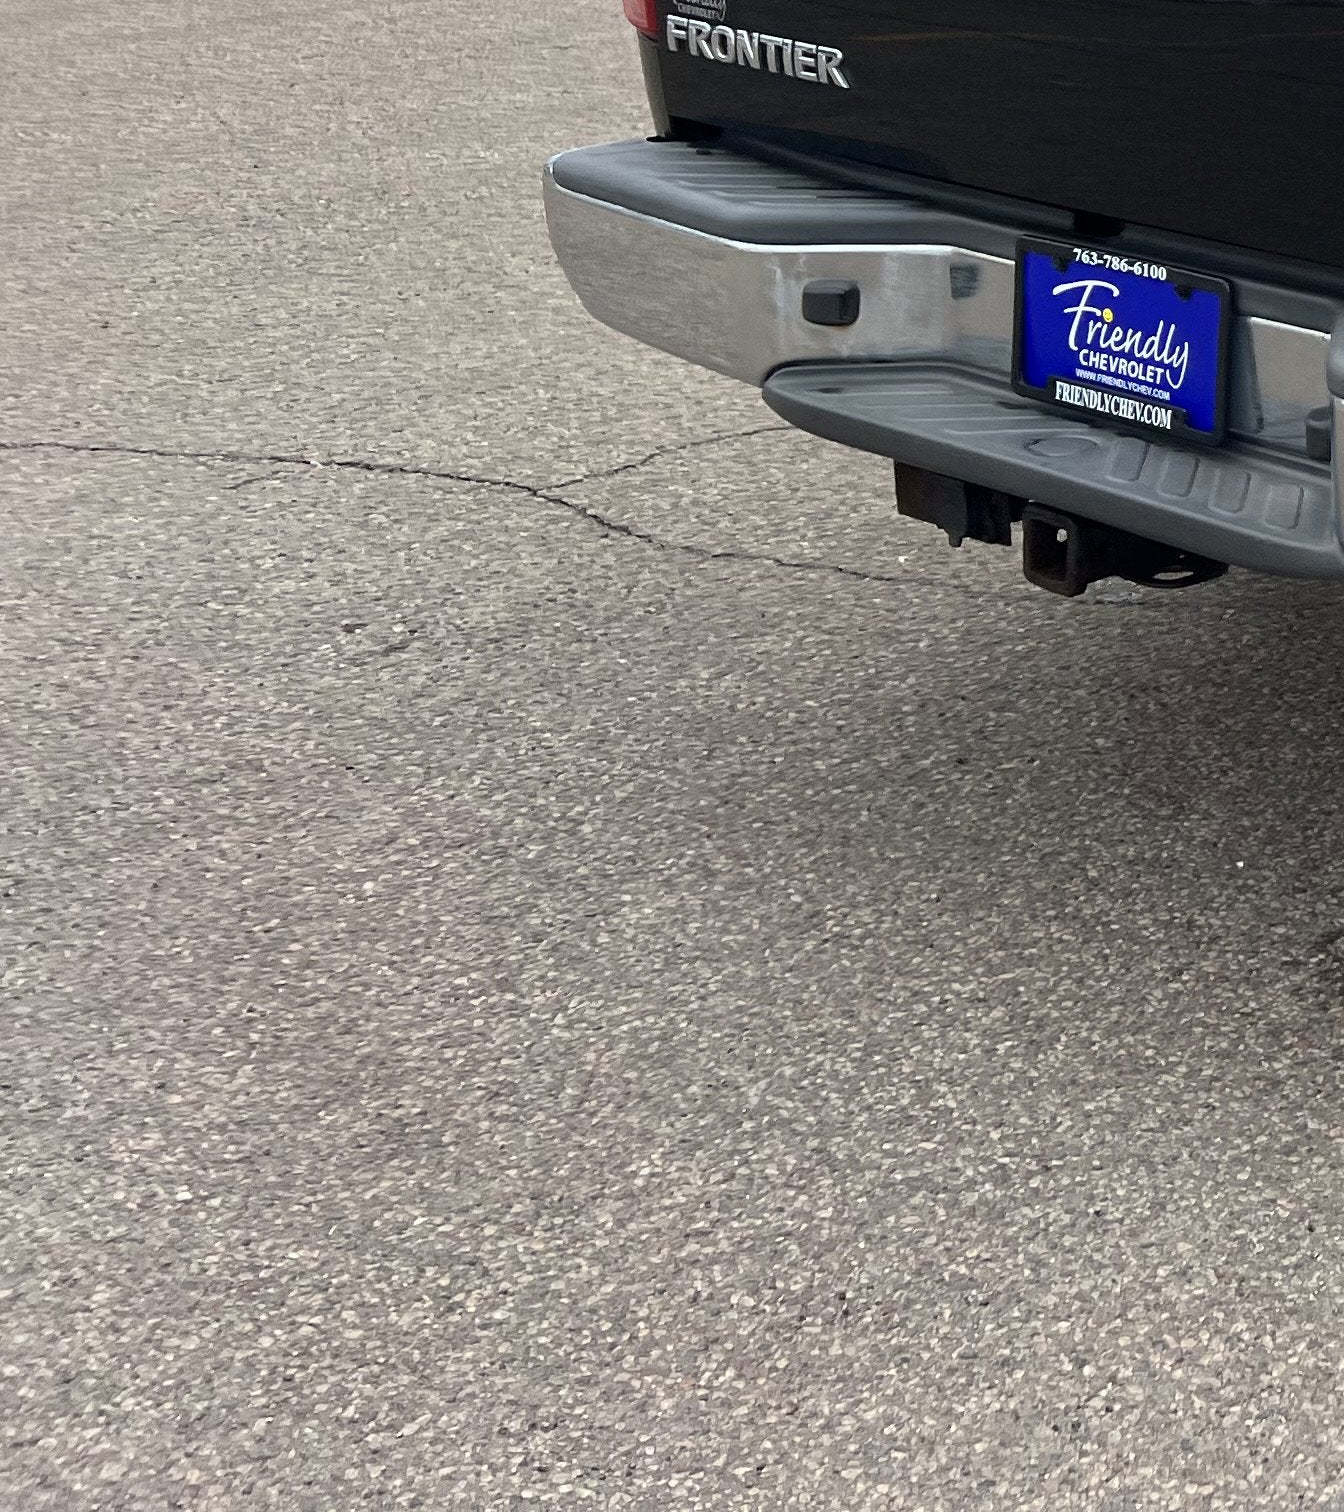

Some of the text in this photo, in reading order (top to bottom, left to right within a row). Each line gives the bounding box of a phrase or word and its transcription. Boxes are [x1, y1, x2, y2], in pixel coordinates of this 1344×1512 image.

[666, 14, 850, 89] FRONTIER
[1072, 248, 1167, 281] 763-786-6100
[1052, 279, 1189, 389] Friendly
[1075, 367, 1170, 401] WWW.FRIENDLYCHEV.COM
[1079, 348, 1164, 385] CHEVROLET
[1055, 380, 1172, 430] FRIENDLYCHEV.COM
